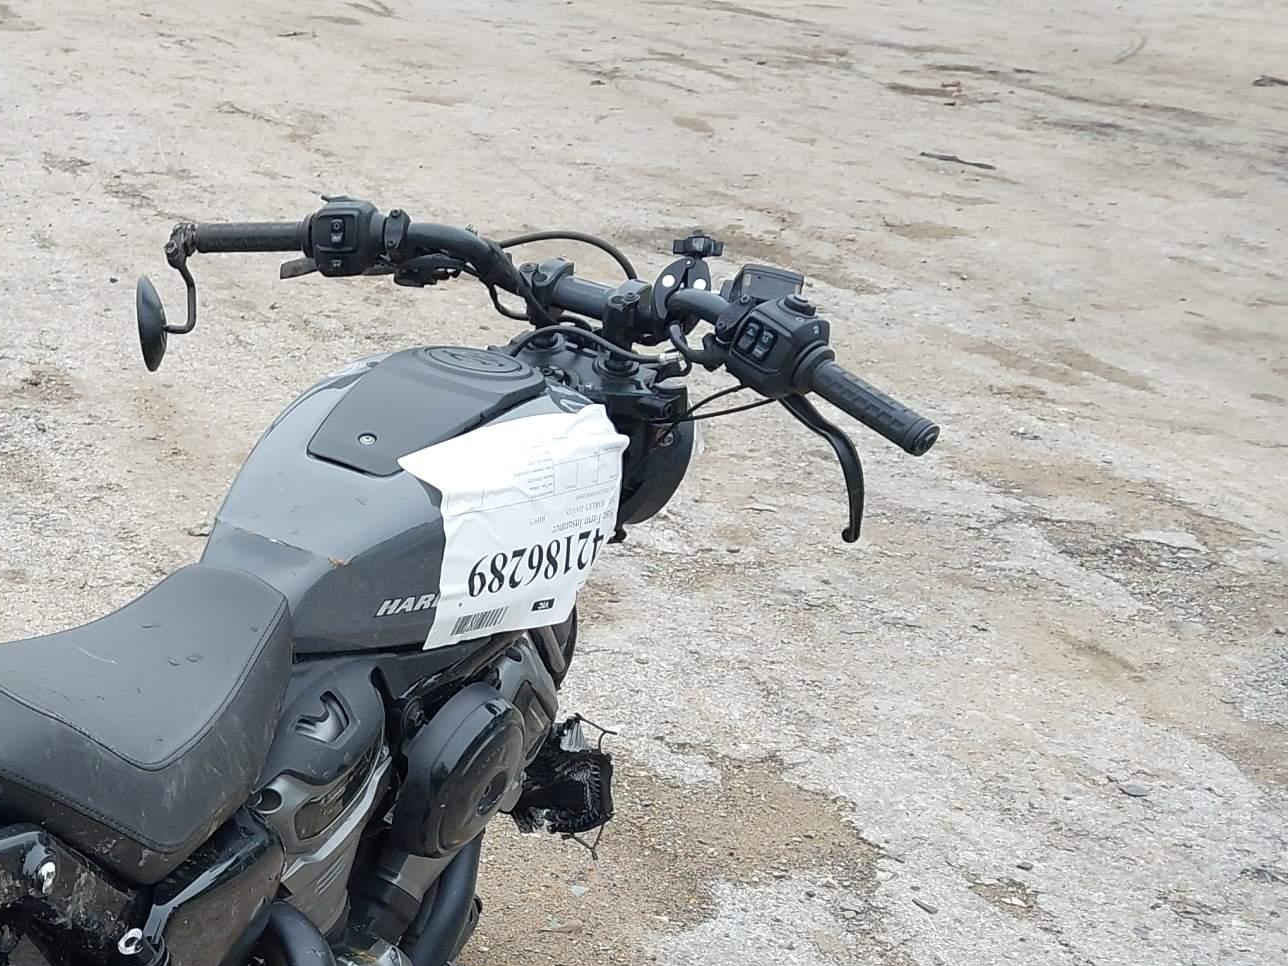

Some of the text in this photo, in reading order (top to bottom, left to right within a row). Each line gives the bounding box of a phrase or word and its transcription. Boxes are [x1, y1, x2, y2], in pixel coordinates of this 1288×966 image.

[551, 518, 583, 533] Insurance
[583, 512, 601, 524] Farm
[467, 527, 605, 598] 42186289
